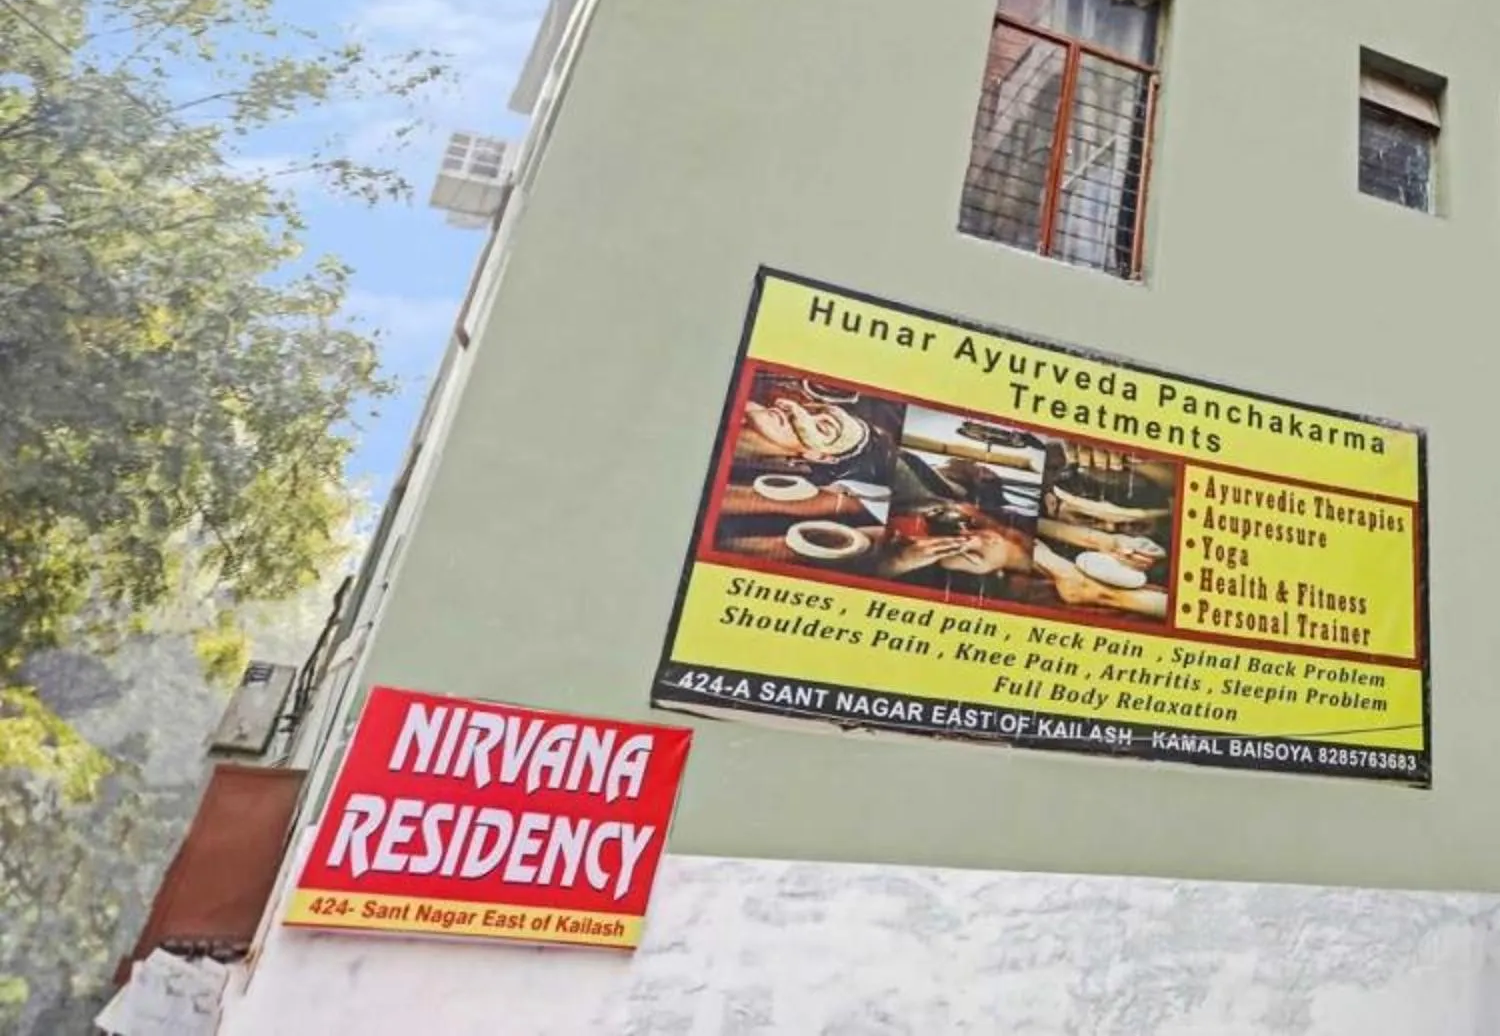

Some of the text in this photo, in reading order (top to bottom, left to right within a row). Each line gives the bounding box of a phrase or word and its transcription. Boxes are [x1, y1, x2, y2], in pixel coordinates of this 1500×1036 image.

[808, 296, 1386, 455] Hunar Ayurveda Panchakarma
[1009, 383, 1222, 453] Treatments
[1203, 508, 1328, 548] Acupressure
[1204, 475, 1406, 534] Ayurvedic Therapies
[1202, 537, 1249, 570] Yoga
[1197, 600, 1371, 647] Personal Trainer
[1200, 571, 1367, 615] Health & Fitness
[720, 605, 863, 645] Shoulders
[954, 642, 1016, 668] Knee
[1221, 679, 1297, 704] Sleepin
[1305, 688, 1388, 712] Problem
[866, 600, 934, 628] Head
[1027, 626, 1083, 650] Neck
[1171, 646, 1239, 672] Spinal
[1248, 657, 1296, 677] Back
[1304, 664, 1386, 687] Problem
[678, 671, 750, 699] 424-A
[759, 681, 829, 709] SANT
[835, 693, 924, 722] NAGAR
[931, 705, 994, 730] EAST
[1001, 713, 1031, 734] OF
[1037, 718, 1132, 747] KAILASH
[1152, 731, 1223, 756] KAMAL
[1229, 740, 1313, 763] BAISOYA
[993, 676, 1238, 722] Full Body Relaxation
[389, 703, 653, 801] NIRVANA
[327, 793, 657, 900] RESIDENCY
[308, 896, 626, 937] 424- Sant Nagar East of Kailash
